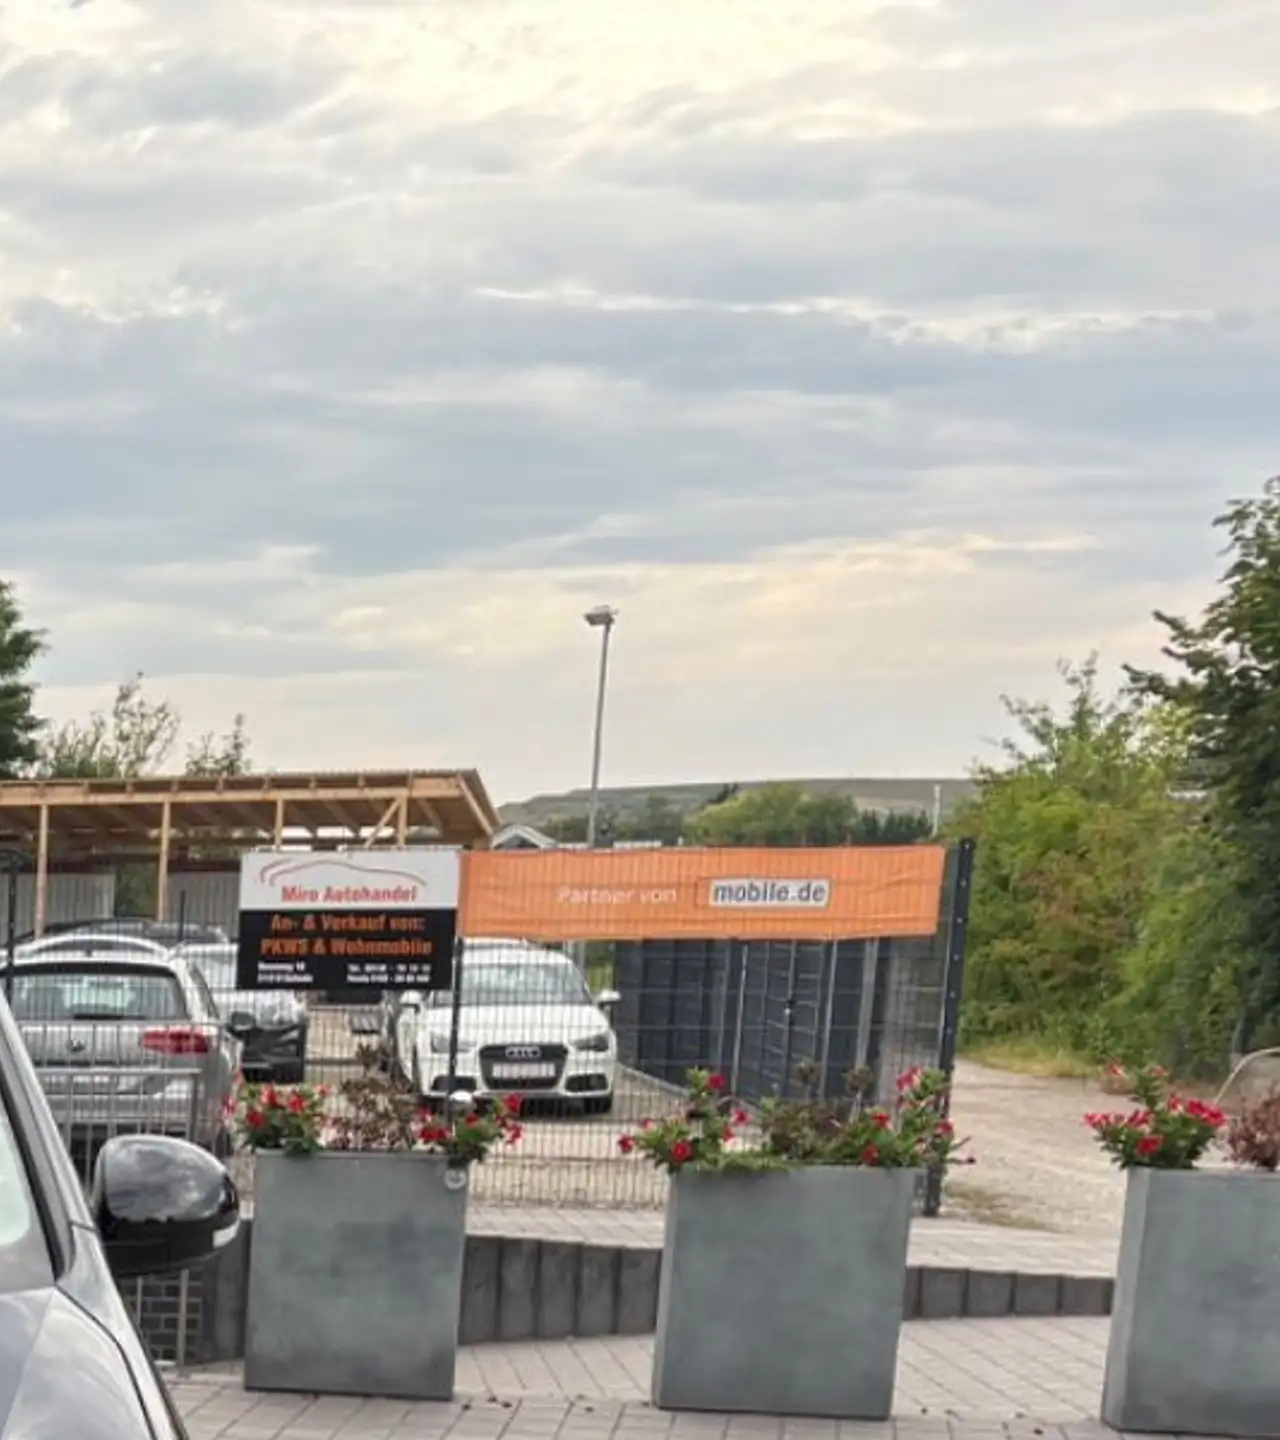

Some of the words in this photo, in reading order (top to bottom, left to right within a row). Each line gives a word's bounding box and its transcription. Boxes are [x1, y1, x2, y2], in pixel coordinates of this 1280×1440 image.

[282, 885, 318, 902] Miro
[324, 885, 417, 902] Autohandel
[557, 886, 635, 905] Partner
[640, 887, 677, 904] von
[713, 880, 827, 903] mobile.de
[321, 914, 385, 931] Verkauf
[332, 938, 432, 955] Wohnmobile
